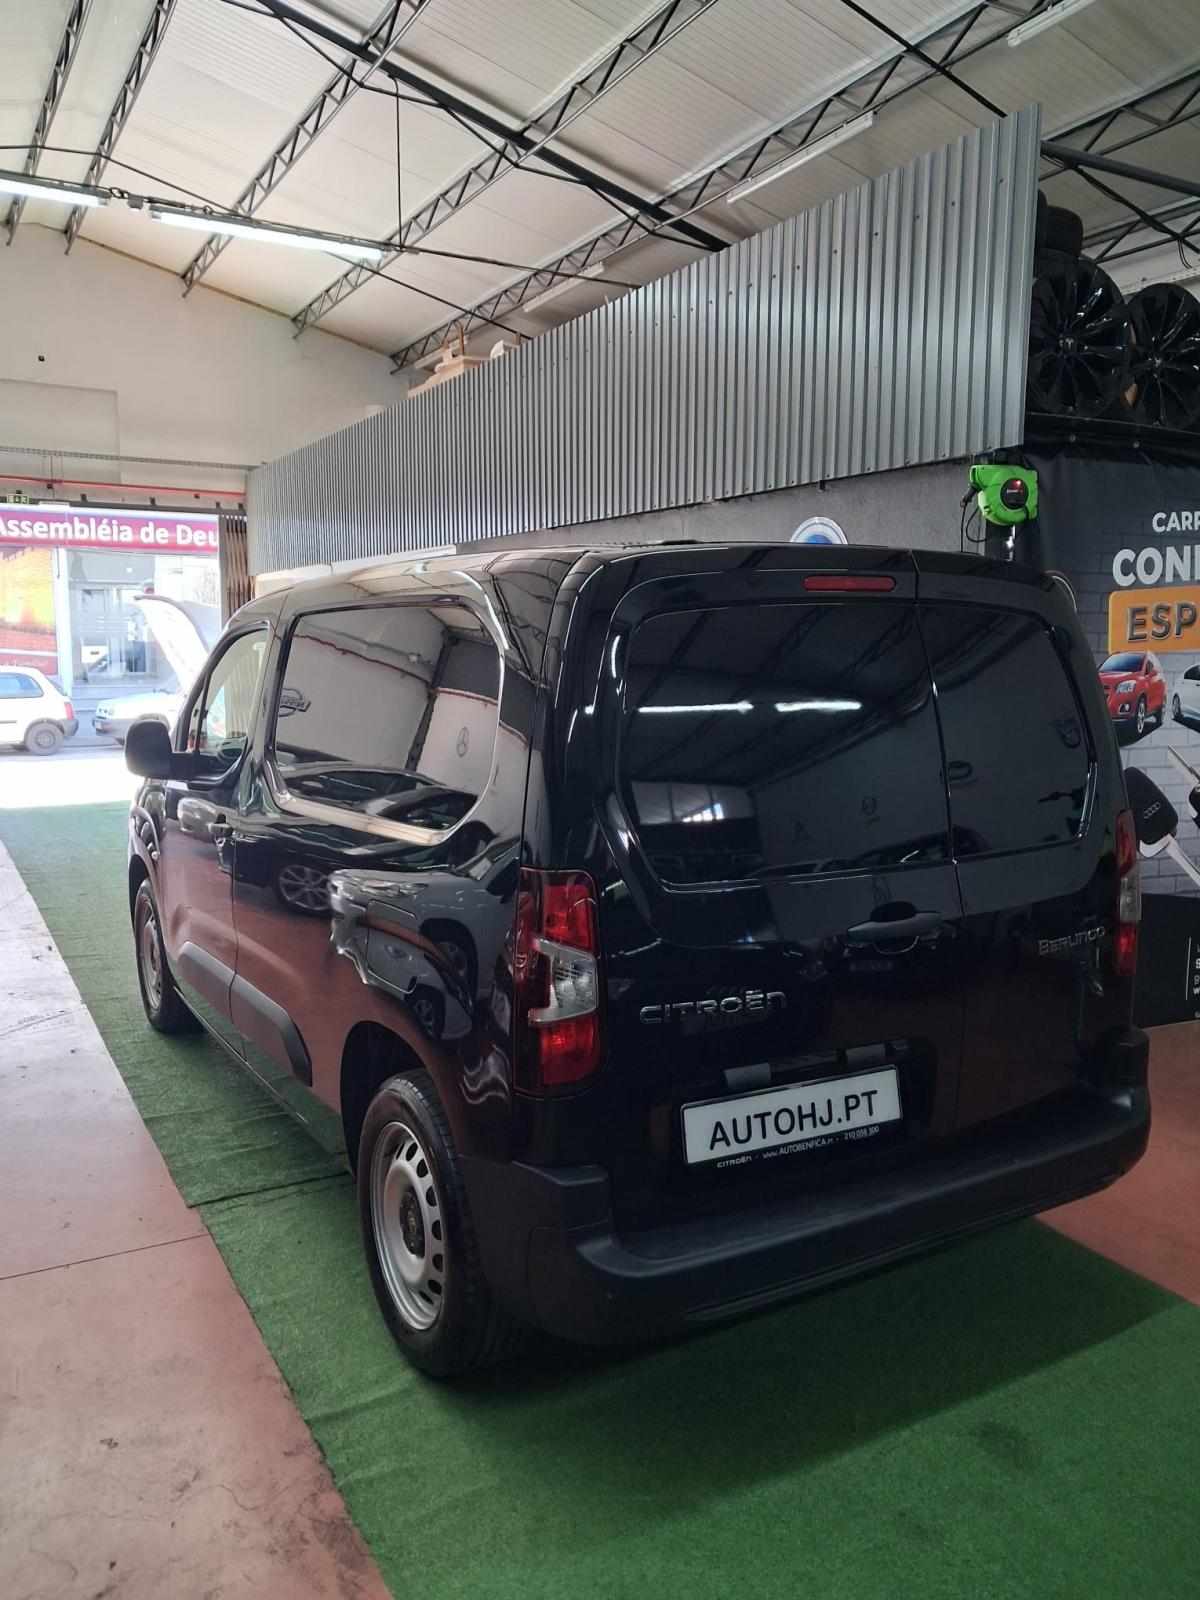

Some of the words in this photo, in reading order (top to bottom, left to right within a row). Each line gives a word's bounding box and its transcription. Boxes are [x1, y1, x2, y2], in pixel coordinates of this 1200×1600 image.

[140, 522, 170, 544] de
[1112, 545, 1200, 587] CON
[1128, 602, 1197, 643] ESP
[710, 1089, 878, 1150] AUTOHJ.PT
